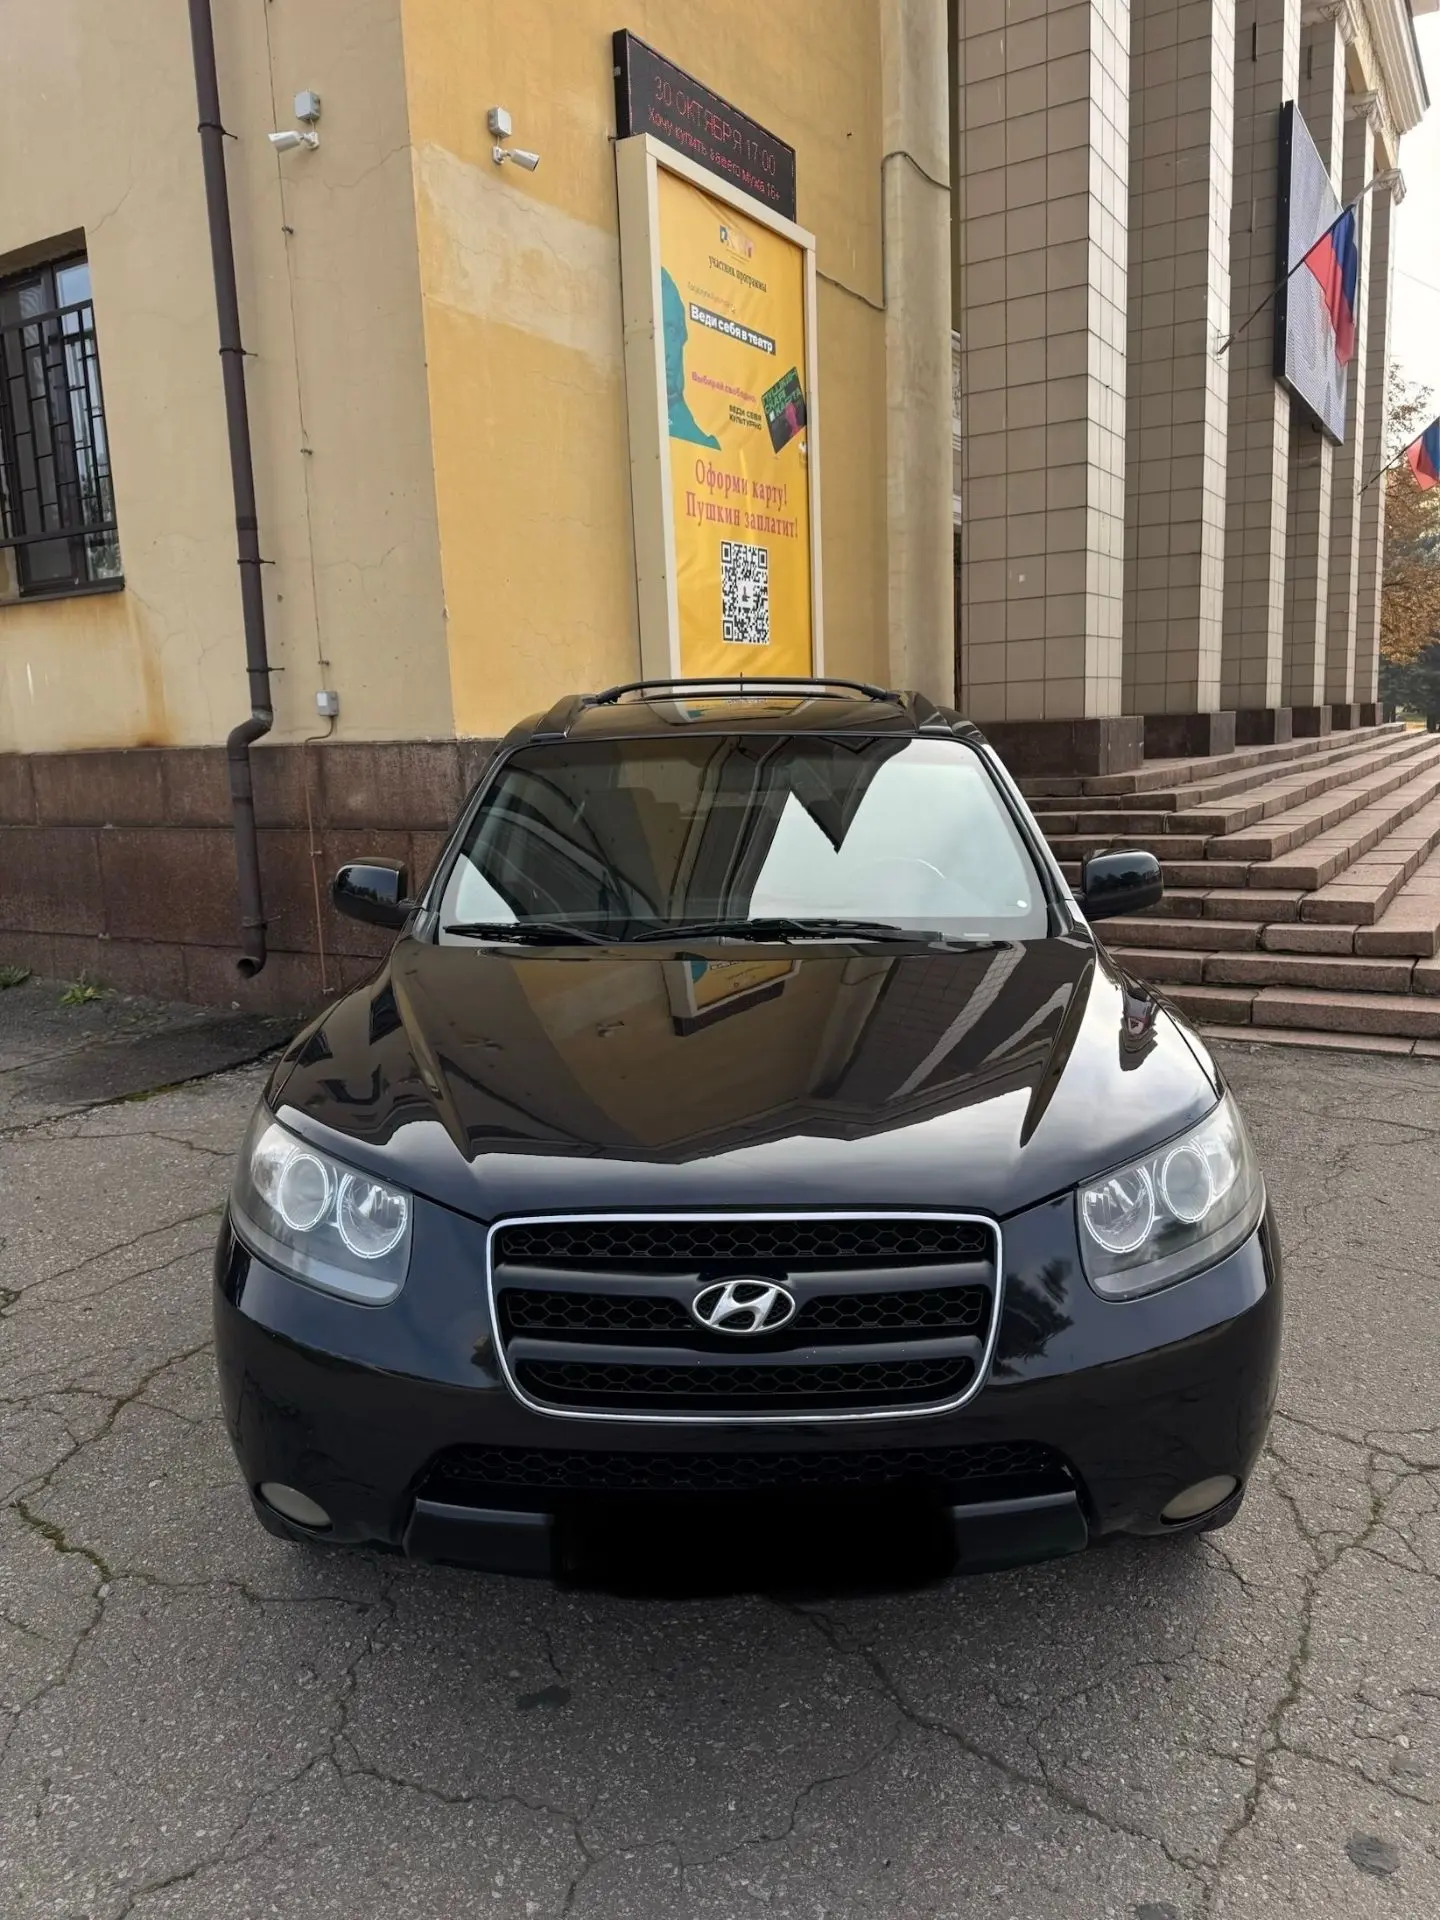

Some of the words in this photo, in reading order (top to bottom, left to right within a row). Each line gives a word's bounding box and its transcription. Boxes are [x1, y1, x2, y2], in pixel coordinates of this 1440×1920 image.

[654, 76, 672, 107] 30
[690, 304, 718, 328] Веди
[718, 319, 741, 337] себя
[741, 330, 748, 341] в
[748, 333, 773, 354] театр
[695, 459, 748, 499] Оформи
[752, 481, 787, 512] карту!
[686, 491, 740, 526] Пушкин
[744, 511, 798, 539] заплатит!
